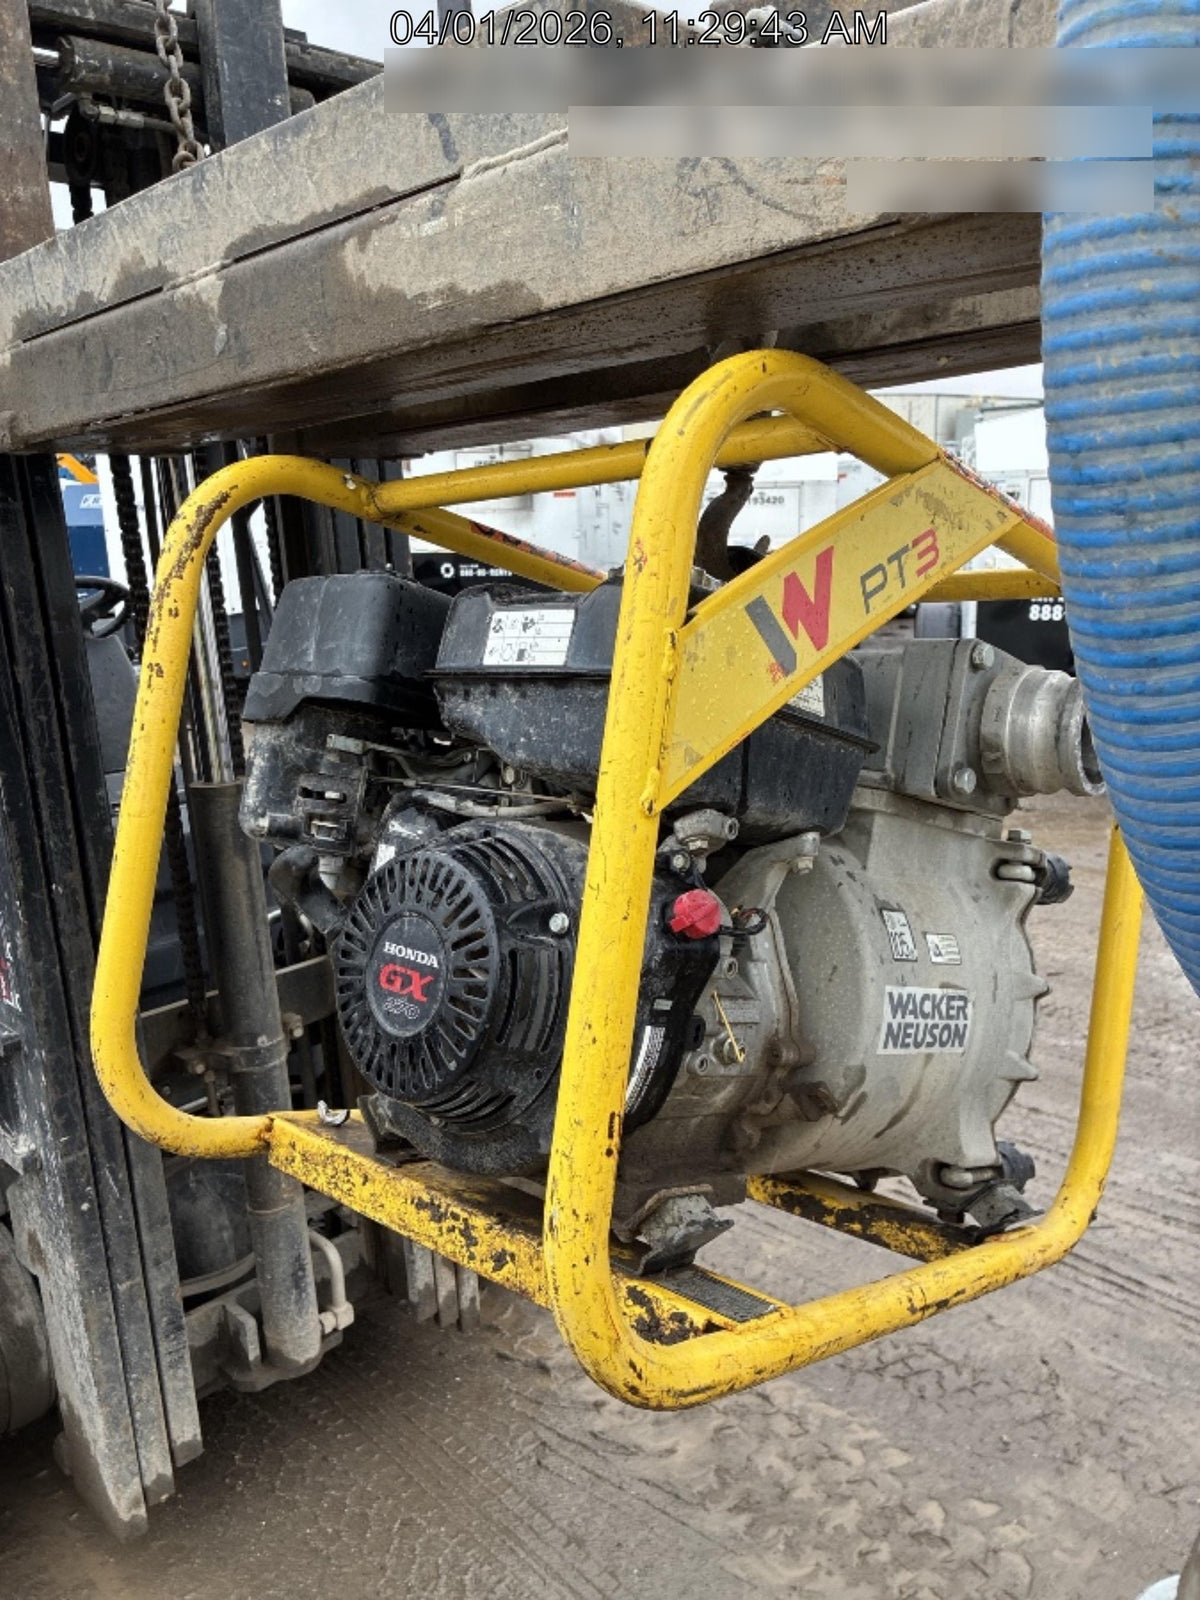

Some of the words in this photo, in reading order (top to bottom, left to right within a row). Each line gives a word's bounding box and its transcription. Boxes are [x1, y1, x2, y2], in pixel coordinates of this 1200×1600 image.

[860, 528, 939, 614] PT3
[383, 942, 439, 968] HONDA
[379, 963, 434, 1003] GX
[888, 992, 968, 1020] WACKER
[883, 1022, 968, 1049] NEUSON
